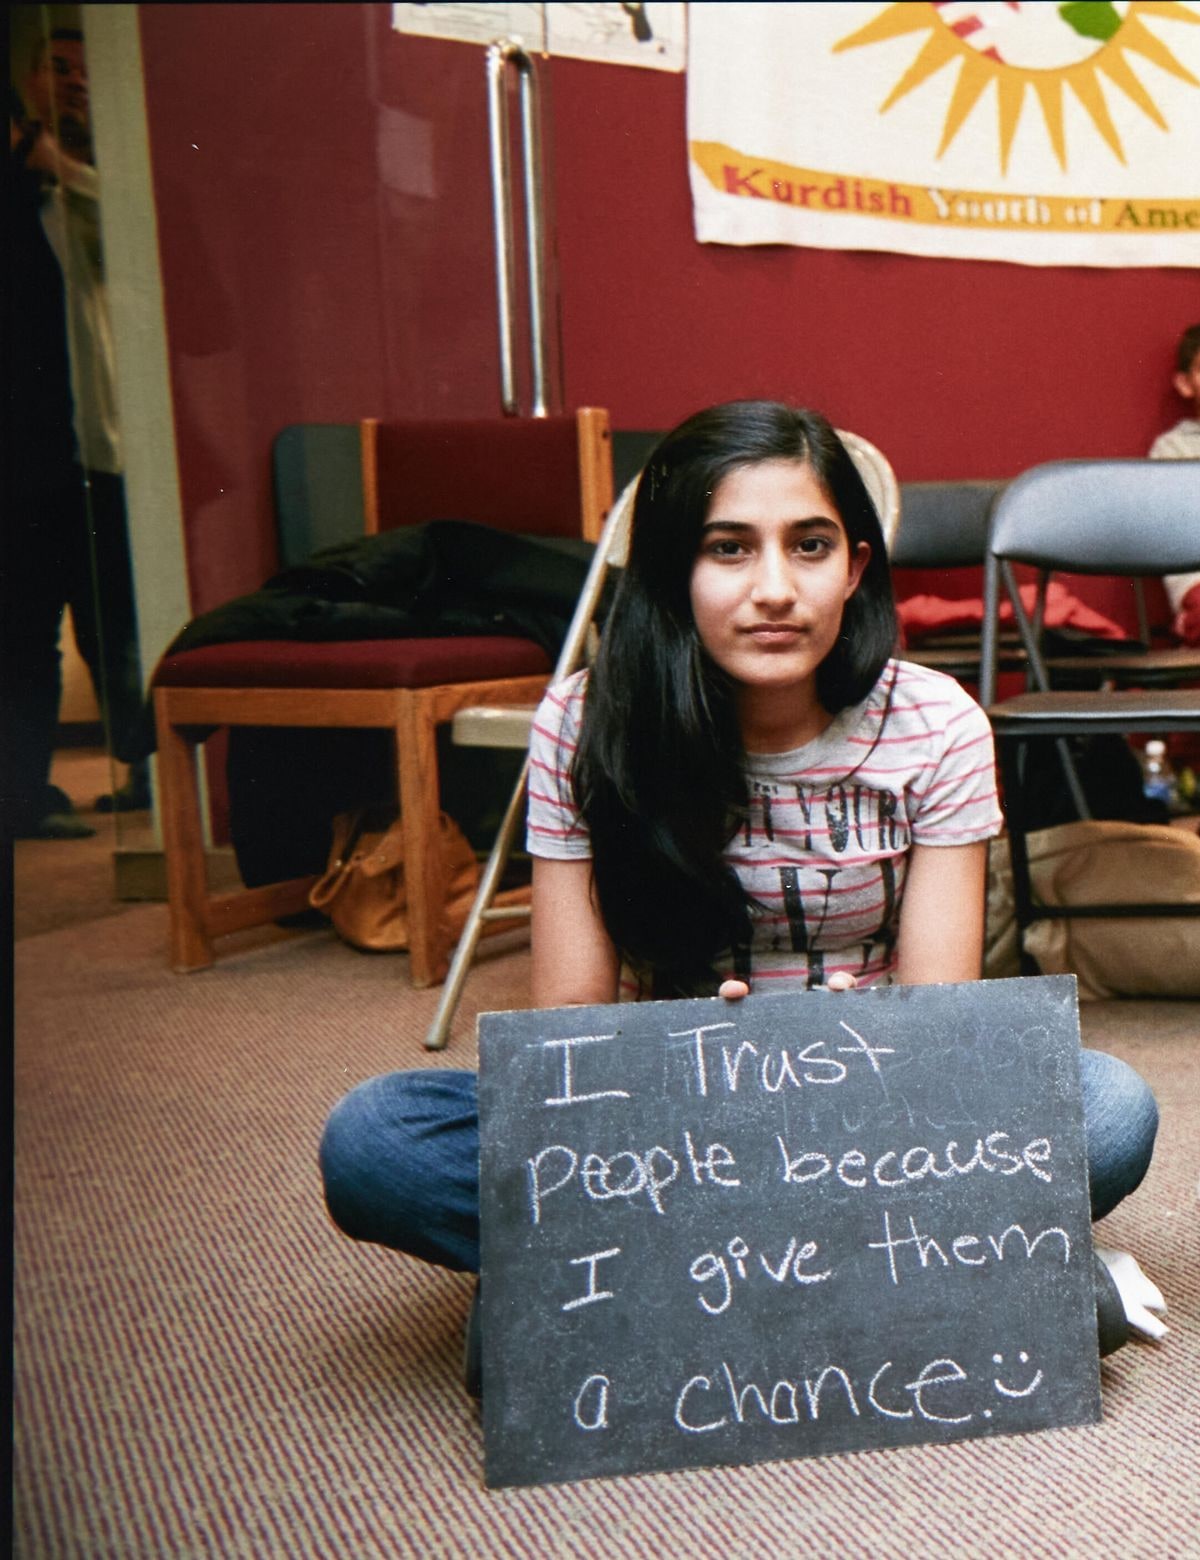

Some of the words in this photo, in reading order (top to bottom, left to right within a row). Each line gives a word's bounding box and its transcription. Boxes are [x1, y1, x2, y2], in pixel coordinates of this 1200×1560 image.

[723, 165, 912, 217] Kurdish
[929, 187, 1050, 224] Youth
[1064, 197, 1106, 226] of
[543, 1034, 631, 1105] I
[668, 1020, 895, 1098] Trust
[528, 1131, 740, 1224] people
[777, 1131, 1053, 1188] because
[562, 1248, 620, 1310] I
[690, 1236, 832, 1314] give
[868, 1211, 1070, 1284] them
[573, 1375, 608, 1429] a
